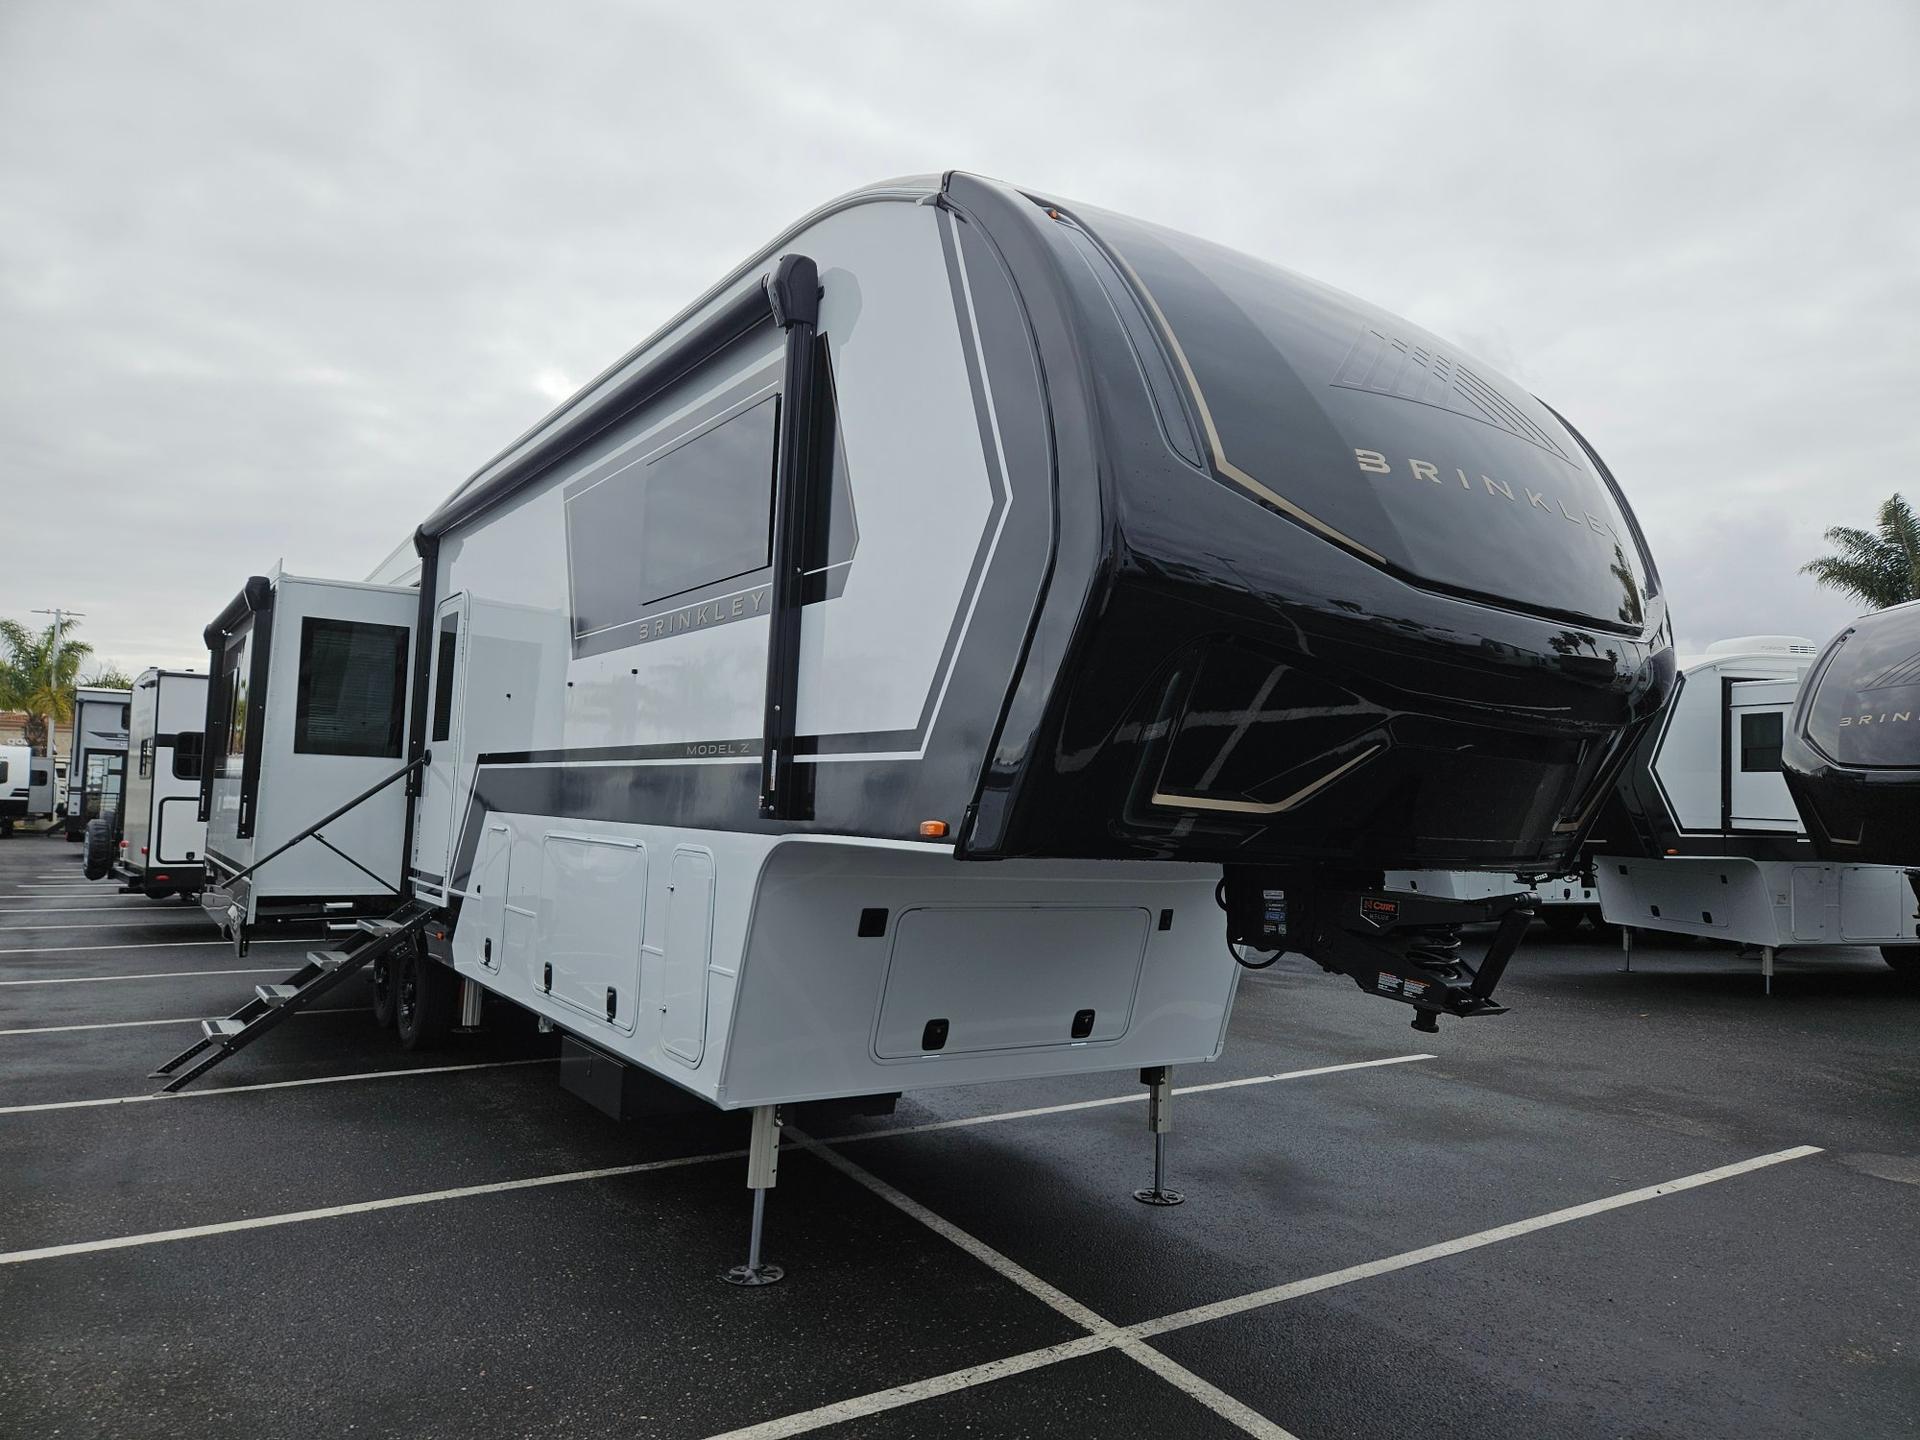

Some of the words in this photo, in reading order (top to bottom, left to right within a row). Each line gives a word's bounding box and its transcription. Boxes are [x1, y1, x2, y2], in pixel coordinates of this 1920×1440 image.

[1354, 447, 1622, 547] BRINKLEY
[639, 591, 765, 640] BRINKLEY
[1838, 711, 1920, 728] BRIN
[686, 744, 736, 756] MODEL
[740, 743, 750, 753] Z
